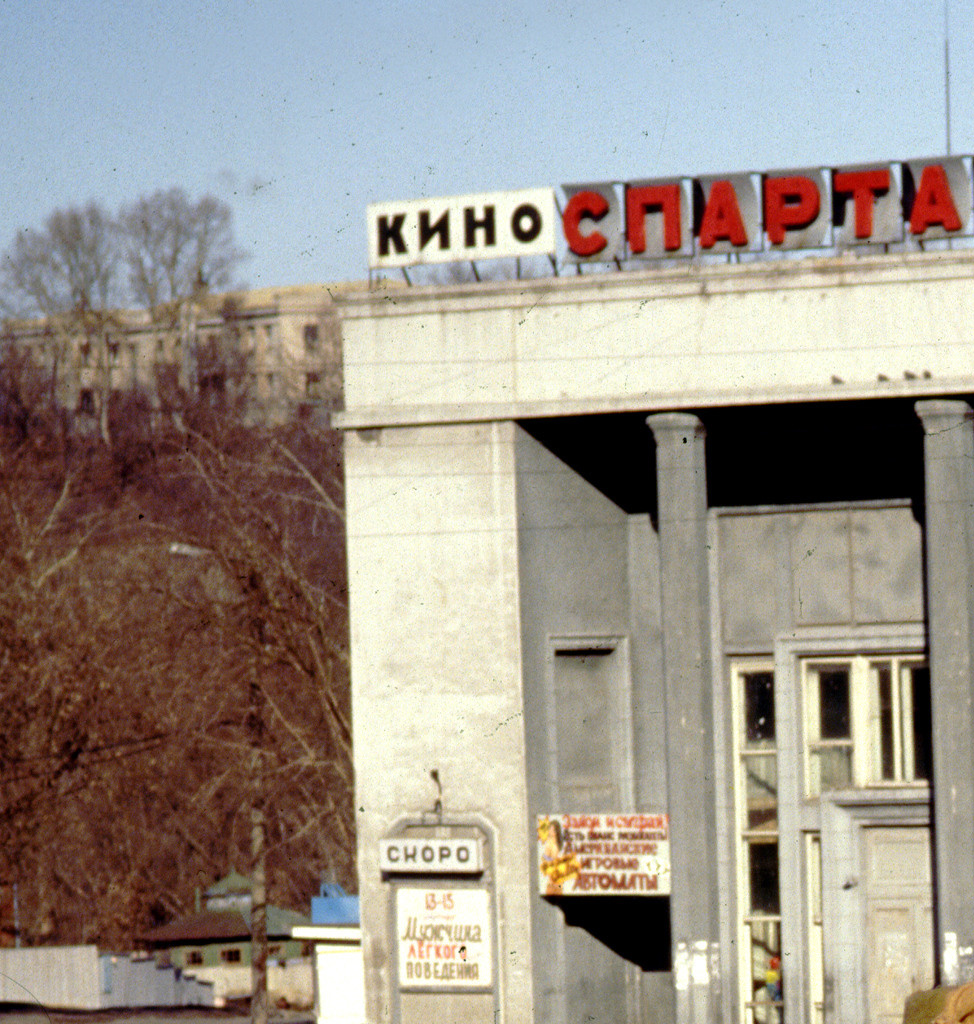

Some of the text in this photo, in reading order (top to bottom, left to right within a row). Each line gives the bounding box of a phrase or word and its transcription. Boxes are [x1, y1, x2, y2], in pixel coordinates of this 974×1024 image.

[377, 203, 543, 256] КИНО
[387, 845, 469, 863] СКОРО
[564, 842, 658, 855] АМЕРИКАНСКИЕ
[580, 858, 639, 870] ИГРОВЫЕ
[572, 873, 658, 891] АВТОМАТЫ
[425, 893, 454, 911] 13-15
[402, 916, 482, 943] Мужчина
[406, 961, 479, 980] ПОВЕДЕНИЯ
